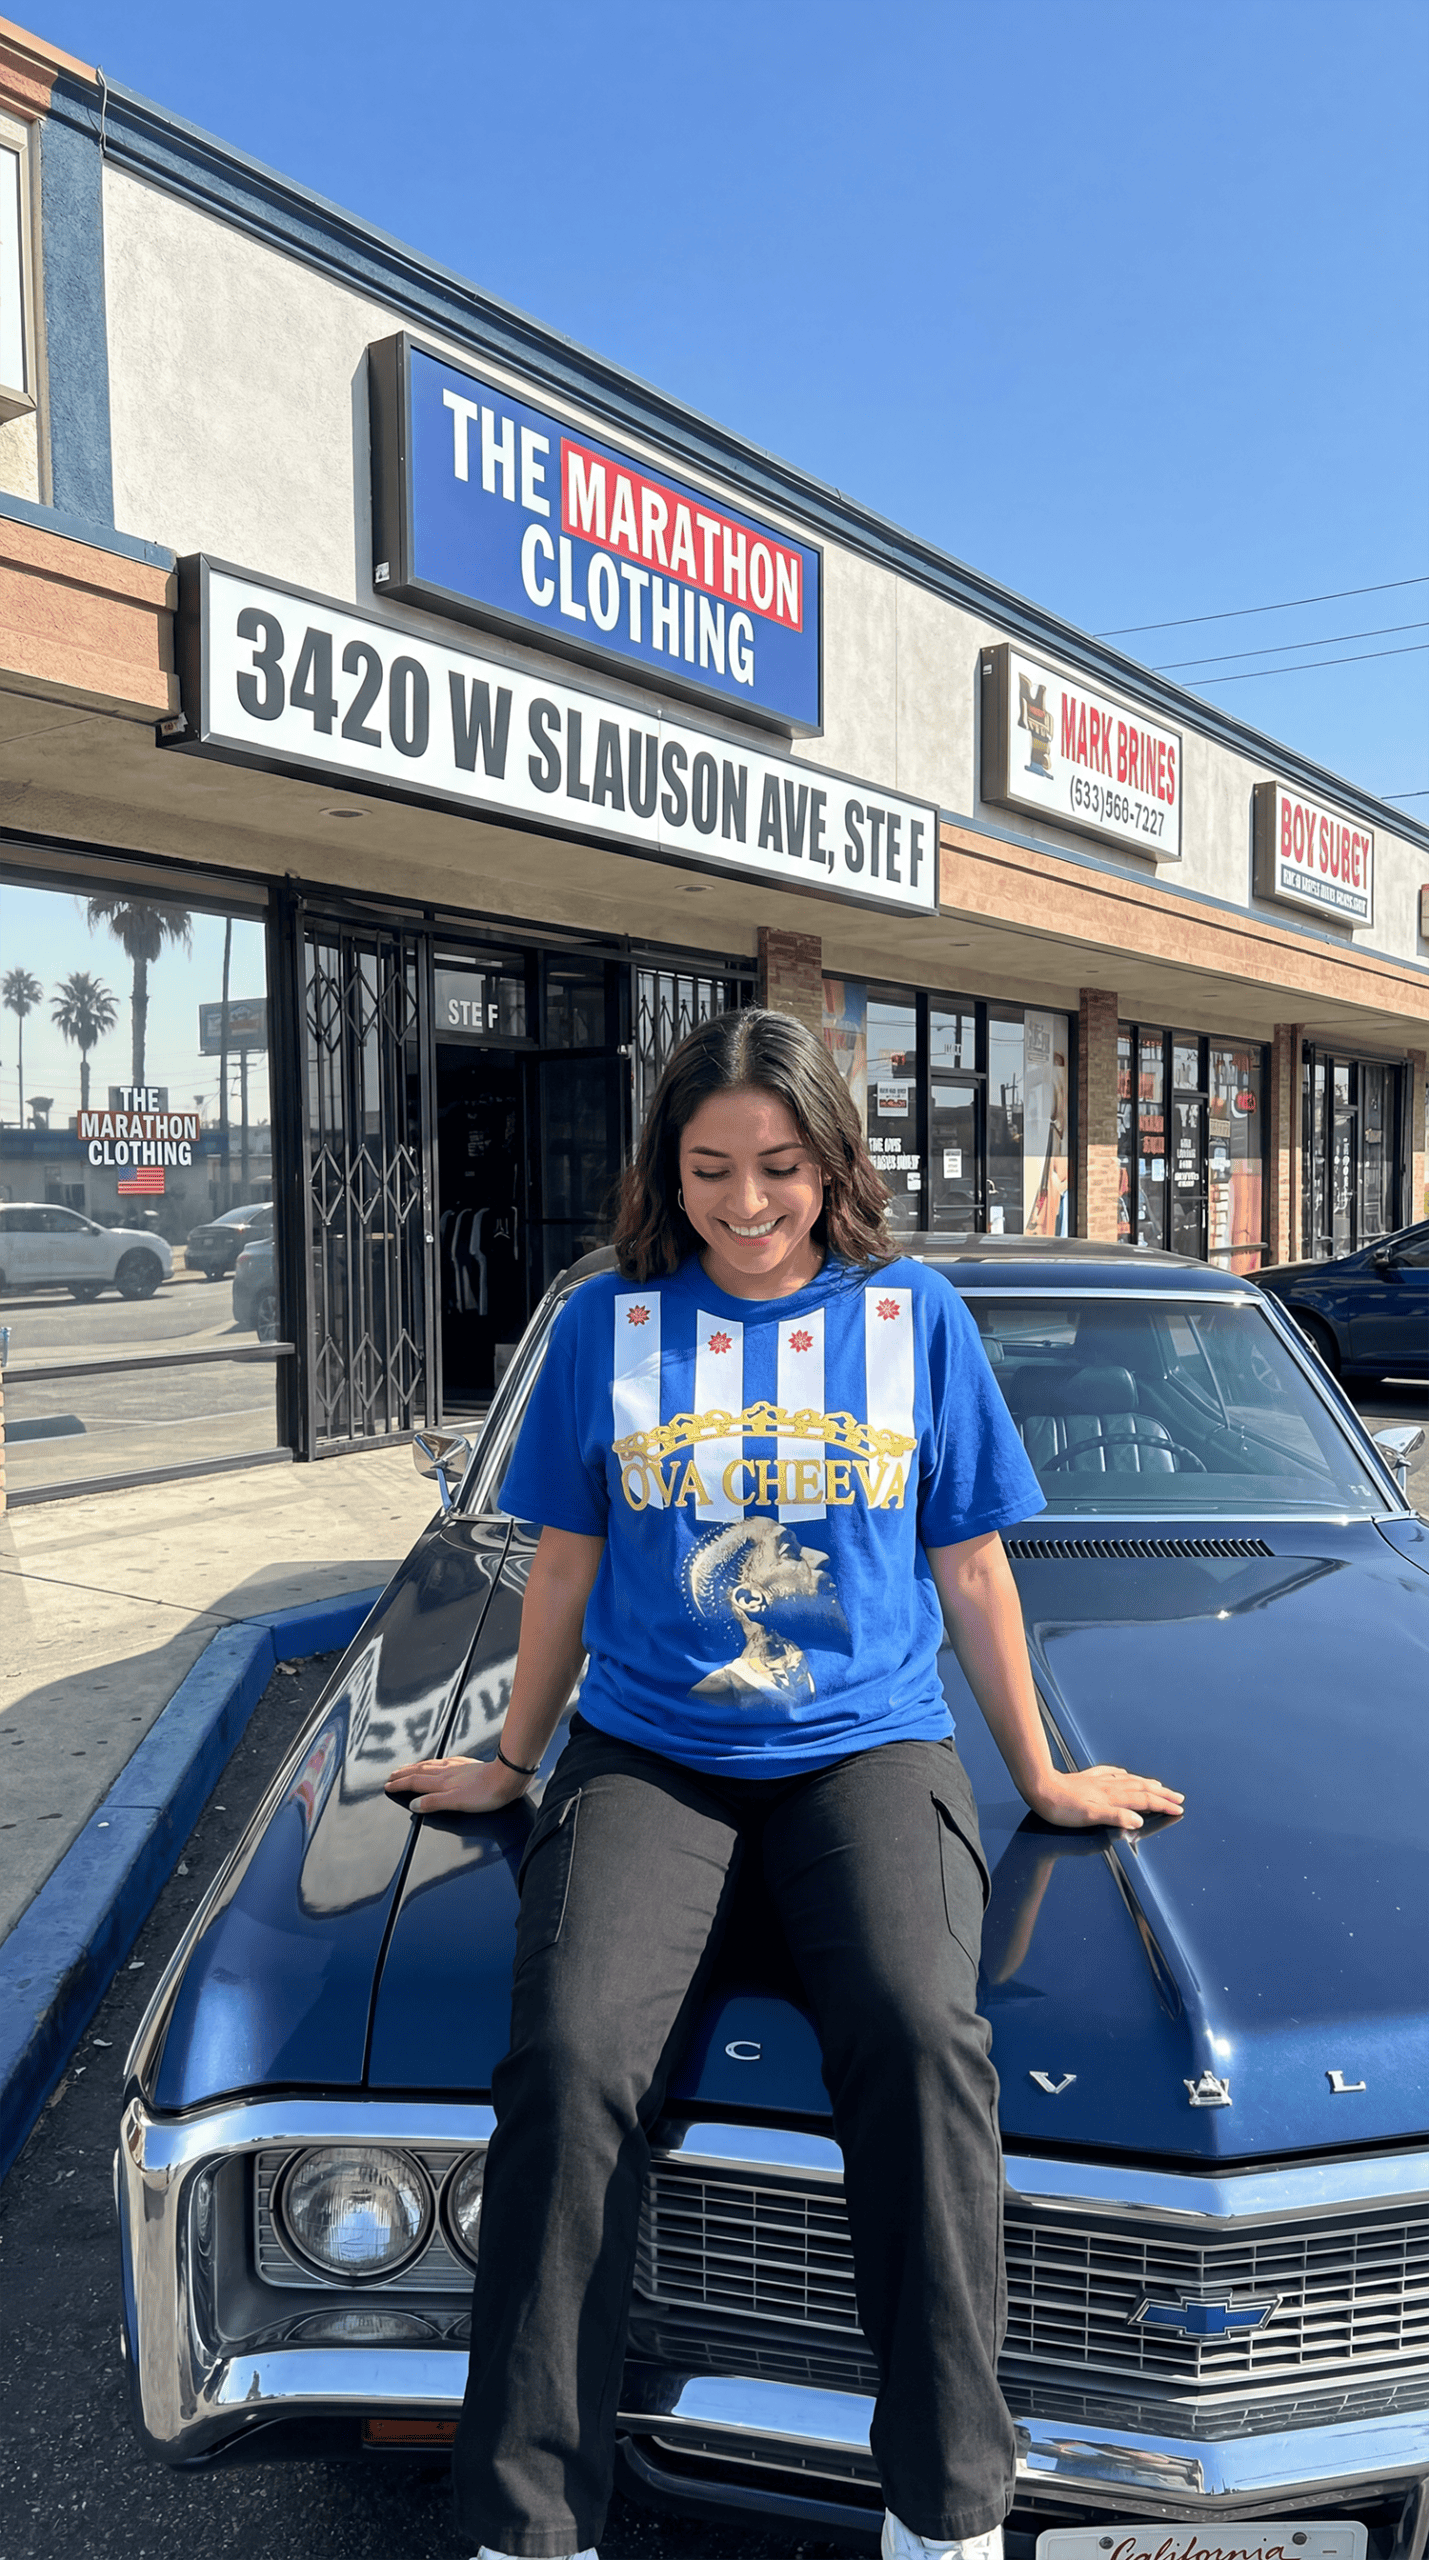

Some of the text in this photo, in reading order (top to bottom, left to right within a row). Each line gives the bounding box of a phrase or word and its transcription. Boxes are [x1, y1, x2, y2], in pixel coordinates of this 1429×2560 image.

[443, 388, 798, 625] THE MARATHON
[521, 523, 755, 687] CLOTHING
[236, 607, 925, 888] 3420 W SLAUSON AVE, STE F
[1060, 691, 1176, 806] MARK BRINES
[1280, 796, 1317, 869] BOY
[448, 998, 499, 1029] STE F
[81, 1112, 197, 1140] MARATHON
[120, 1087, 160, 1112] THE
[88, 1140, 193, 1166] CLOTHING
[621, 1457, 905, 1511] OVA CHEEVA
[725, 2039, 761, 2061] C
[1029, 2070, 1077, 2094] V
[1326, 2069, 1366, 2093] L
